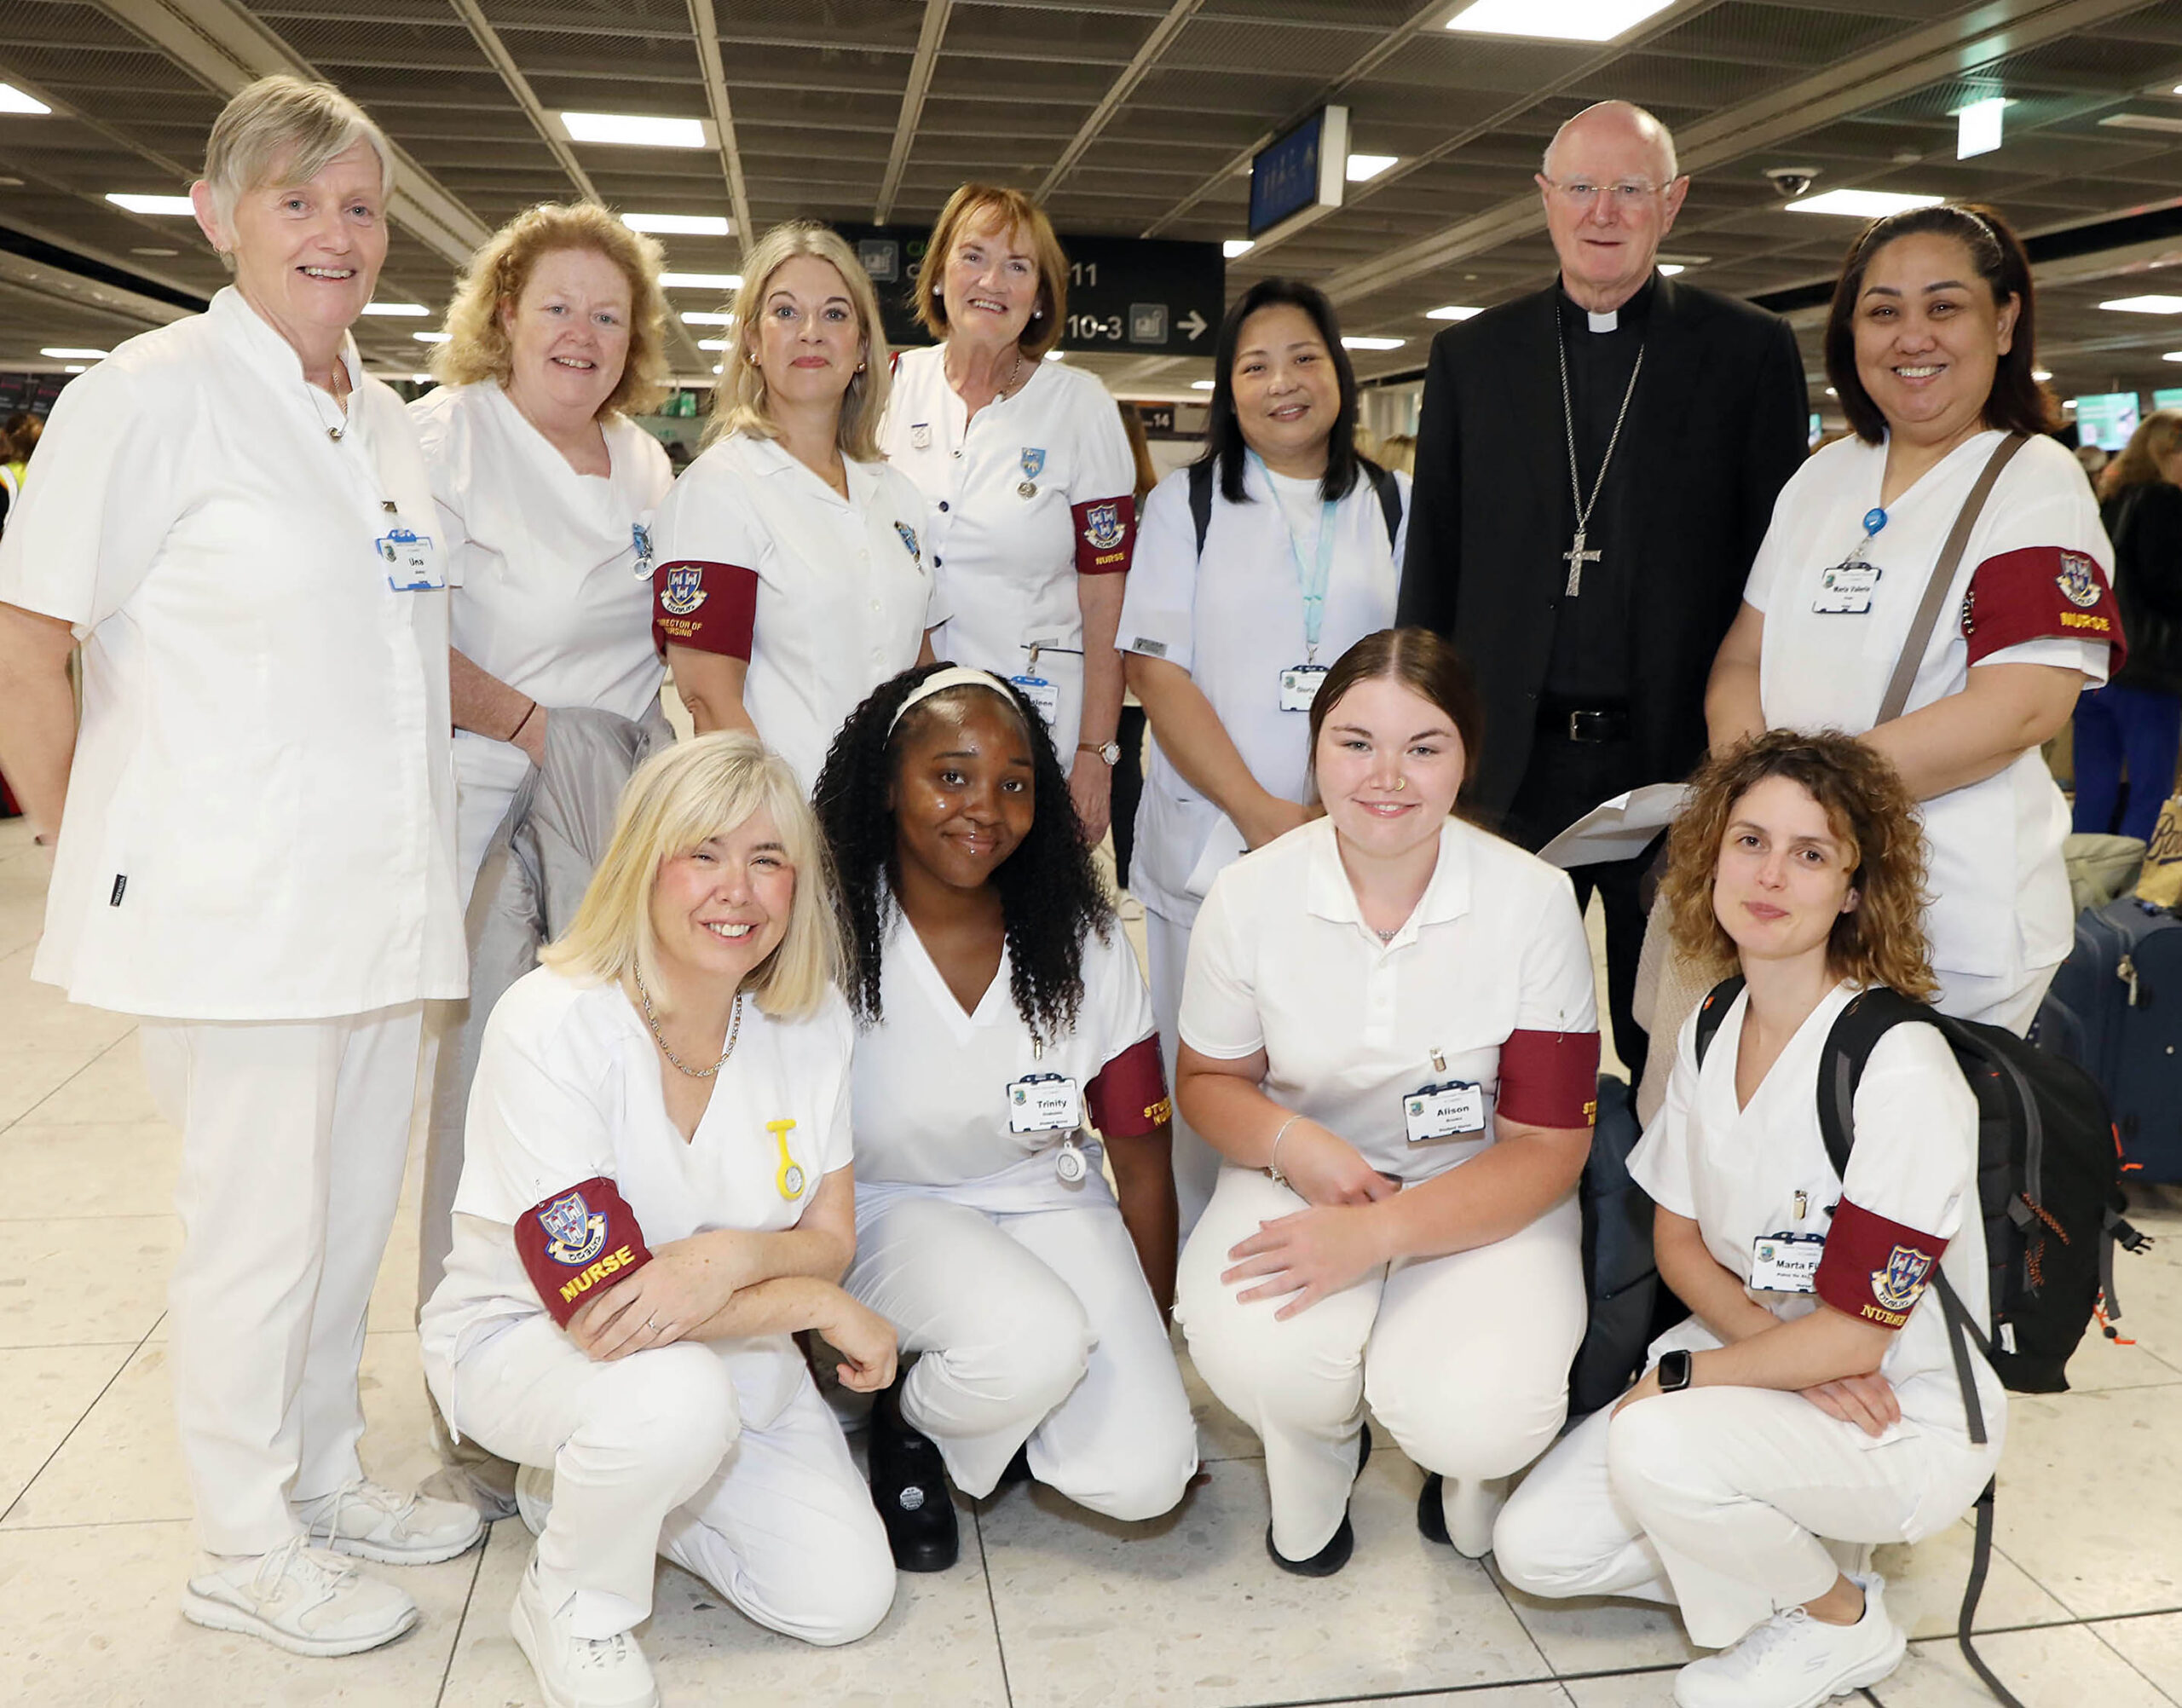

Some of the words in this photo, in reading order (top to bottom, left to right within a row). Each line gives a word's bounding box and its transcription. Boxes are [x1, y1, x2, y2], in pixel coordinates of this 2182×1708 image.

[1068, 314, 1123, 340] 10-3
[409, 557, 424, 566] Una
[1095, 552, 1125, 566] NURSE
[691, 621, 703, 631] OF
[2059, 611, 2110, 632] NURSE
[1036, 1099, 1067, 1109] Trinity
[1436, 1105, 1469, 1117] Alison
[1775, 1260, 1805, 1270] Marta
[559, 1245, 637, 1304] NURSE
